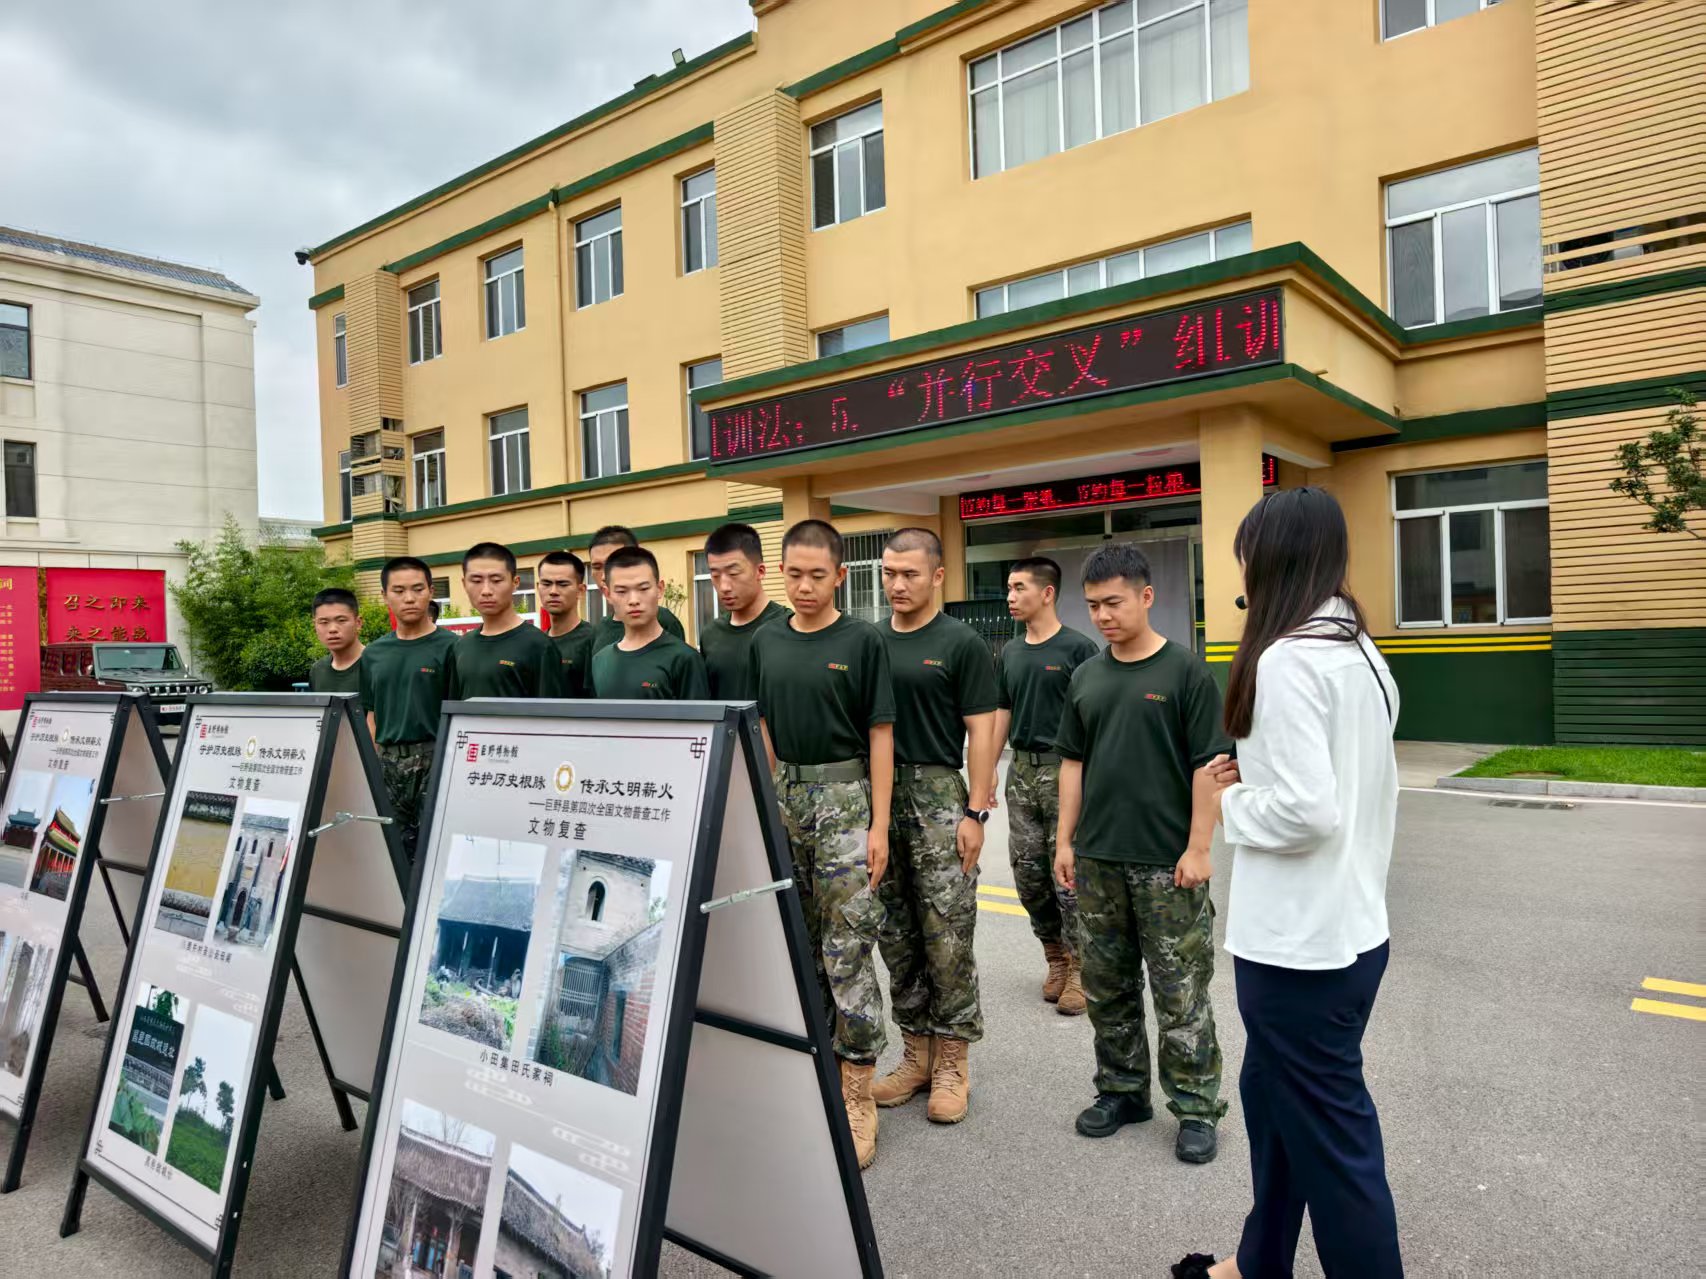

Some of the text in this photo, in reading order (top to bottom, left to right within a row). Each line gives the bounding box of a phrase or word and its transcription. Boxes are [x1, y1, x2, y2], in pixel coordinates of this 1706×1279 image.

[64, 594, 150, 611] 召之即来
[480, 744, 519, 758] 巨野博物馆
[467, 771, 674, 800] 守护历史根脉 传承文明薪火
[527, 817, 588, 841] 文物复查
[479, 1048, 555, 1087] 小田集田氏家祠
